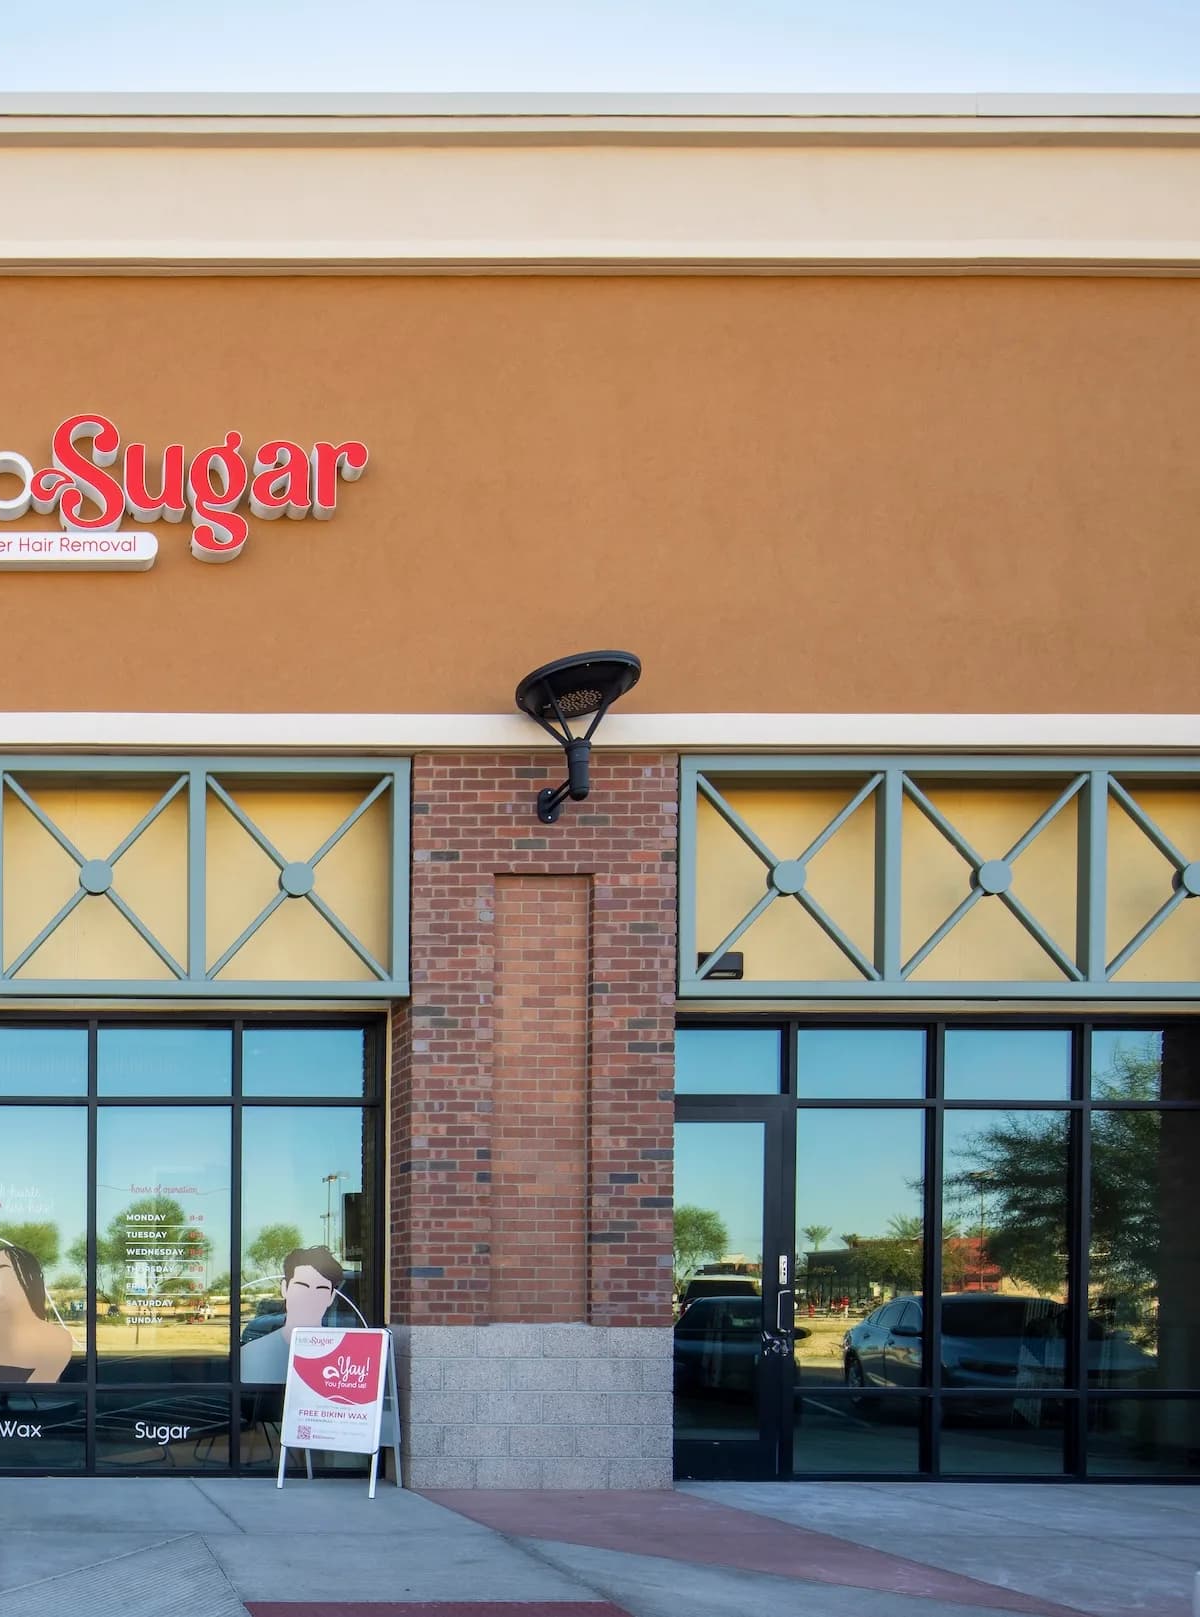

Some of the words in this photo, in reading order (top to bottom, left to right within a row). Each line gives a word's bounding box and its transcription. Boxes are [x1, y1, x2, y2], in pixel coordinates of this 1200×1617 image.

[31, 413, 368, 556] Sugar
[19, 537, 54, 553] Hair
[60, 537, 137, 553] Removal
[128, 1183, 152, 1193] hours
[126, 1282, 158, 1290] FRDAY
[126, 1299, 174, 1307] SATURDAY
[126, 1316, 163, 1324] SUNDAY
[337, 1355, 370, 1382] Yay!
[337, 1381, 357, 1389] found
[298, 1409, 319, 1417] FREE
[320, 1410, 346, 1418] BIKINI
[347, 1412, 368, 1420] WAX
[134, 1421, 191, 1445] Sugar
